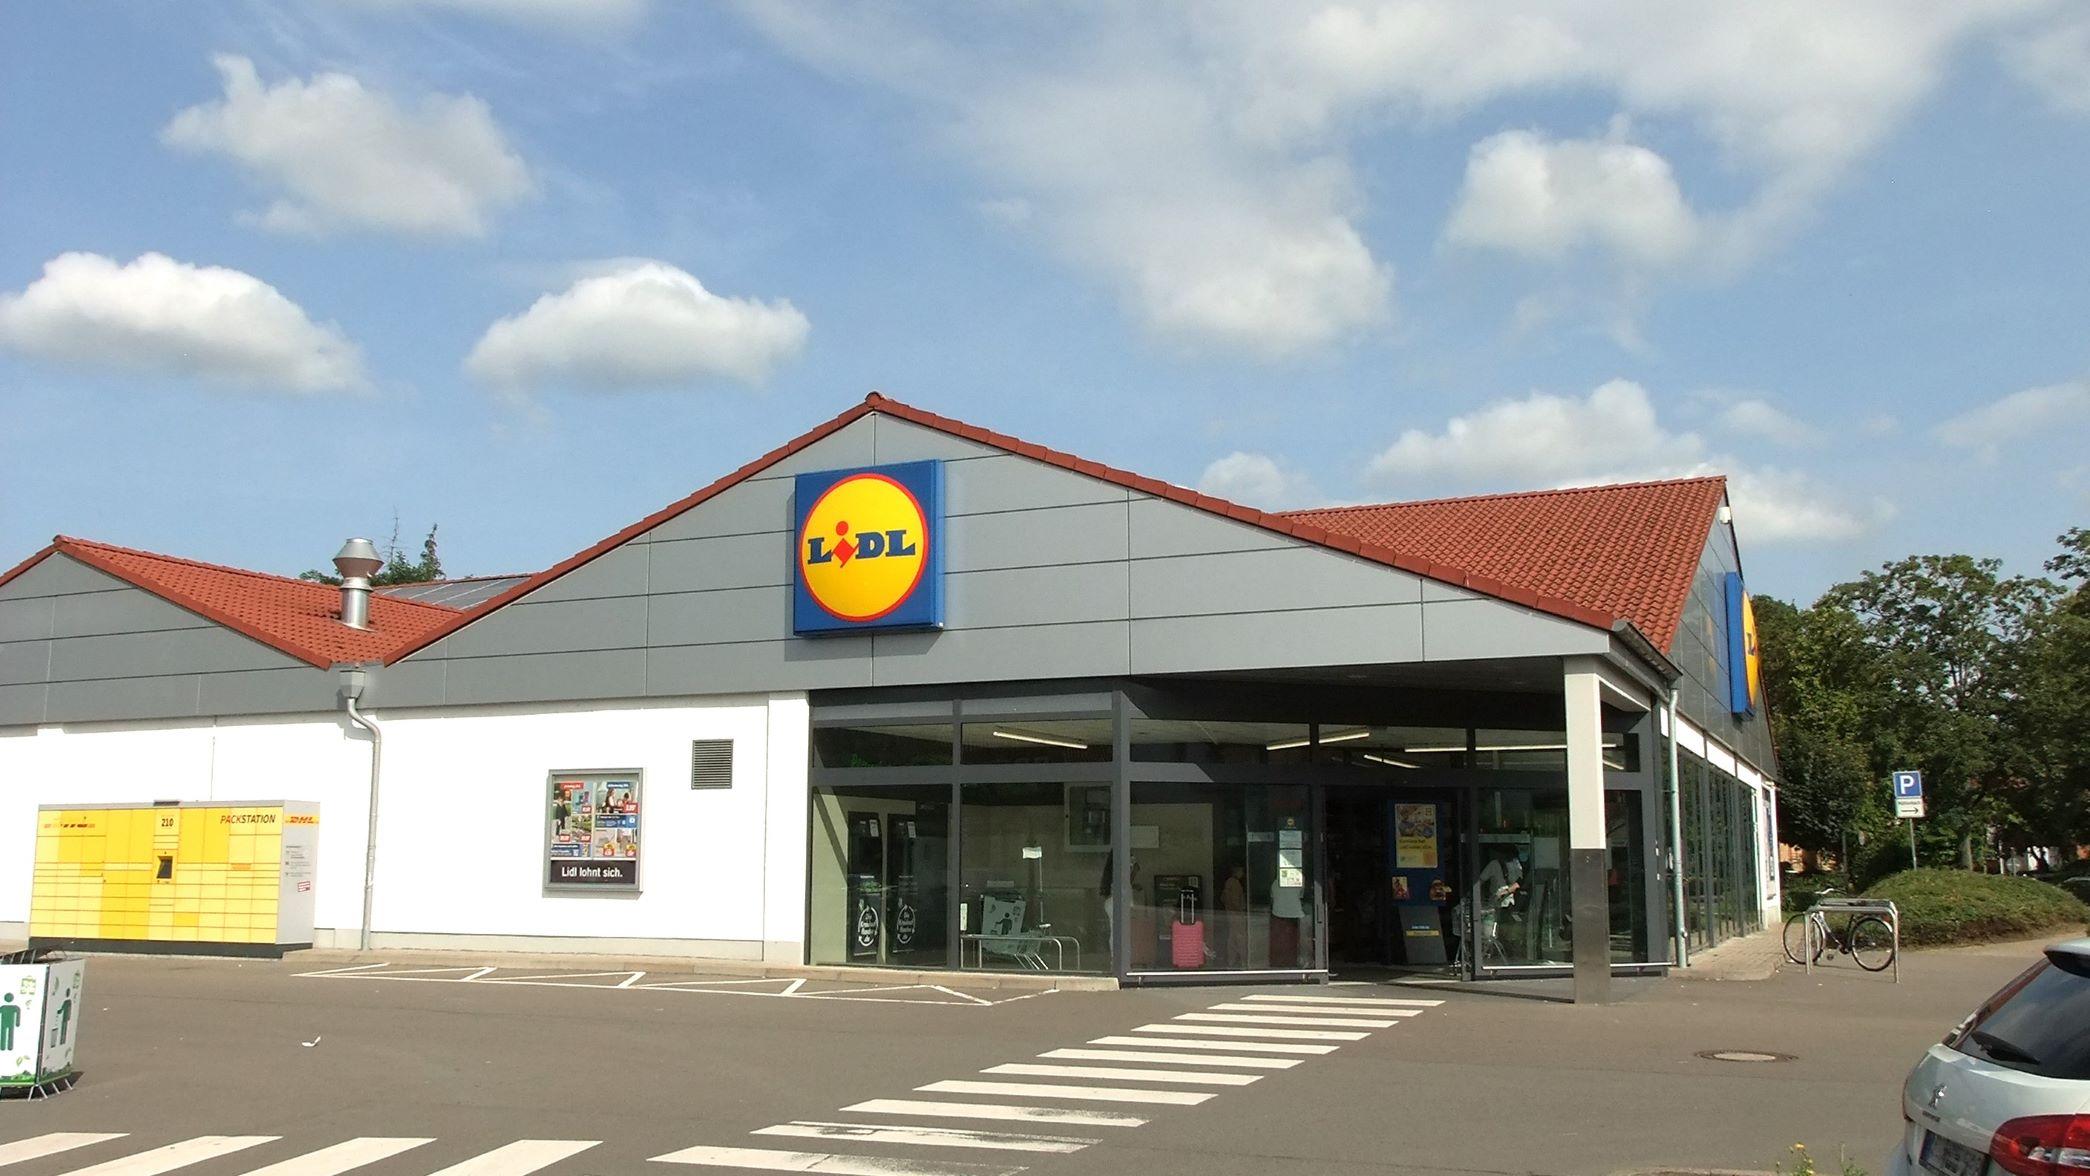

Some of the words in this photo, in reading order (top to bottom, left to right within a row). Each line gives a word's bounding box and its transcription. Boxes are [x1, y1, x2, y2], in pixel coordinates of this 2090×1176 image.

[1899, 775, 1914, 794] P
[161, 818, 174, 827] 210
[220, 814, 276, 824] PACKSTATION
[290, 816, 314, 824] DHL
[561, 867, 578, 878] Lidl
[579, 867, 601, 878] lohnt
[603, 868, 623, 878] sich.
